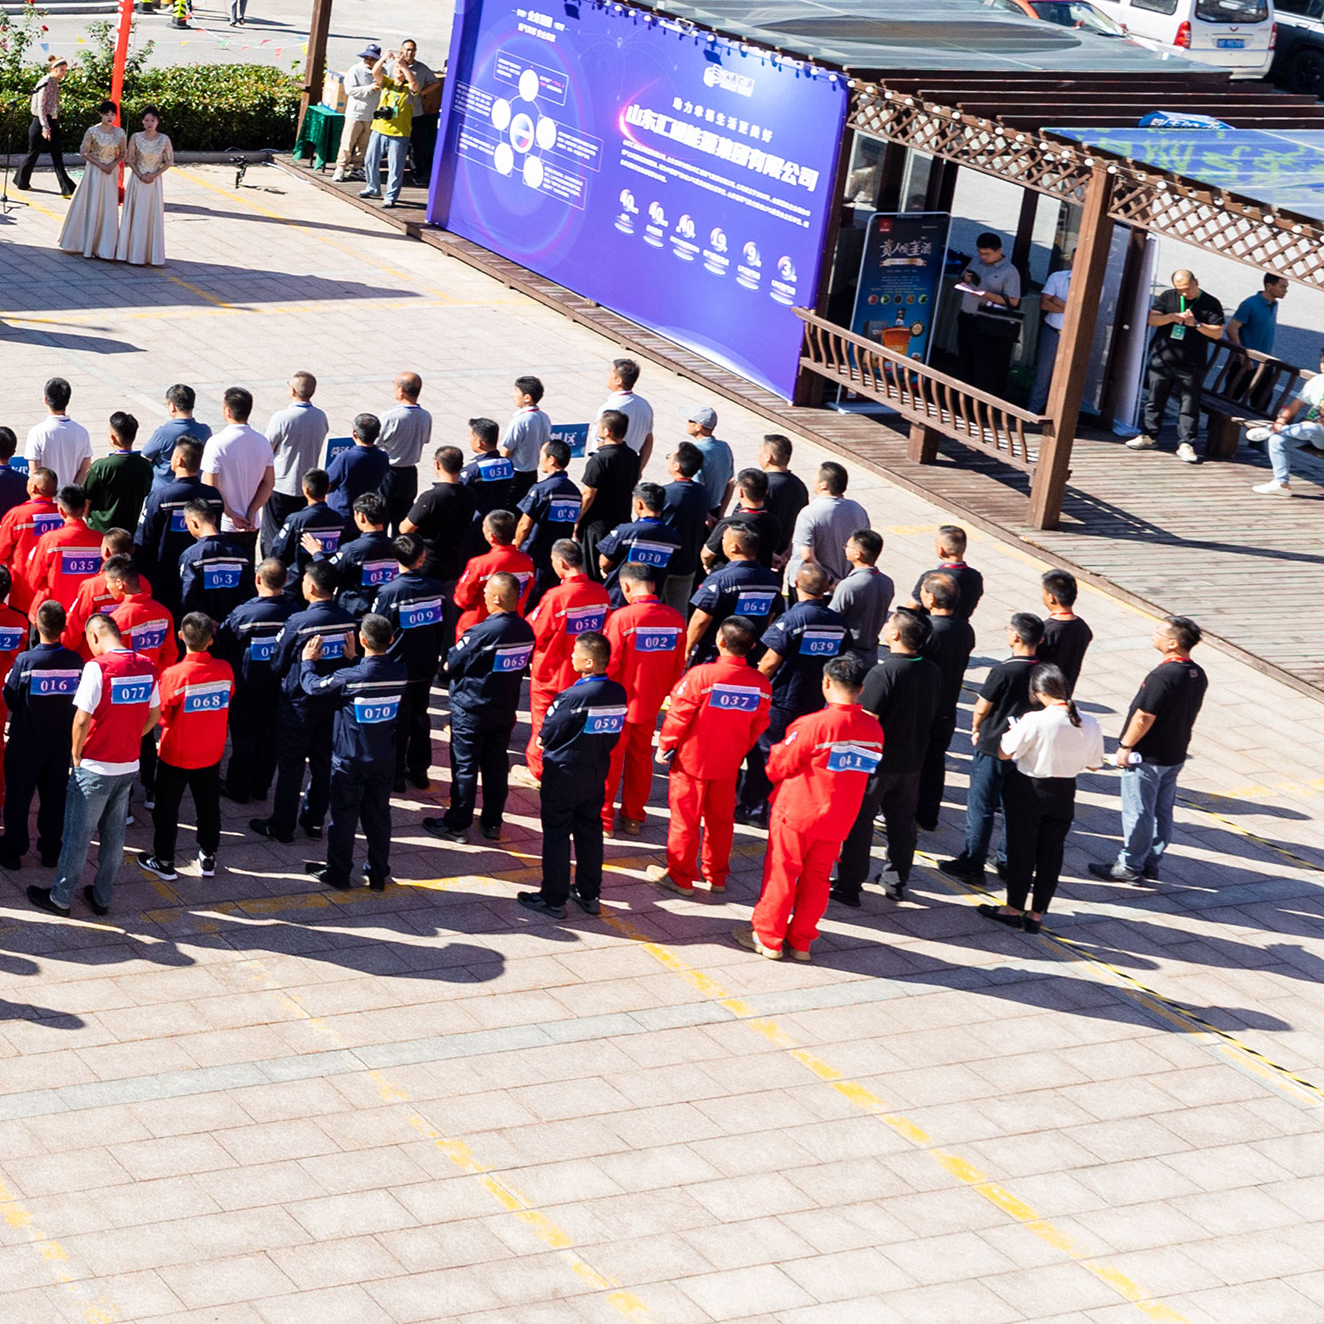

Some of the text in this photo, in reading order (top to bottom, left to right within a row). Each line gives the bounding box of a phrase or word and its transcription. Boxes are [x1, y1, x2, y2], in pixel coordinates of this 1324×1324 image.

[625, 103, 820, 192] 山东汇通能源集团有限公司
[489, 465, 509, 478] 051
[70, 560, 94, 571] 035
[409, 610, 434, 624] 009
[645, 636, 668, 648] 002
[811, 640, 834, 653] 039
[503, 655, 526, 669] 065
[40, 678, 68, 691] 016
[121, 685, 146, 700] 077
[192, 694, 220, 709] 068
[721, 695, 749, 708] 037
[363, 705, 390, 720] 070
[594, 718, 618, 731] 059
